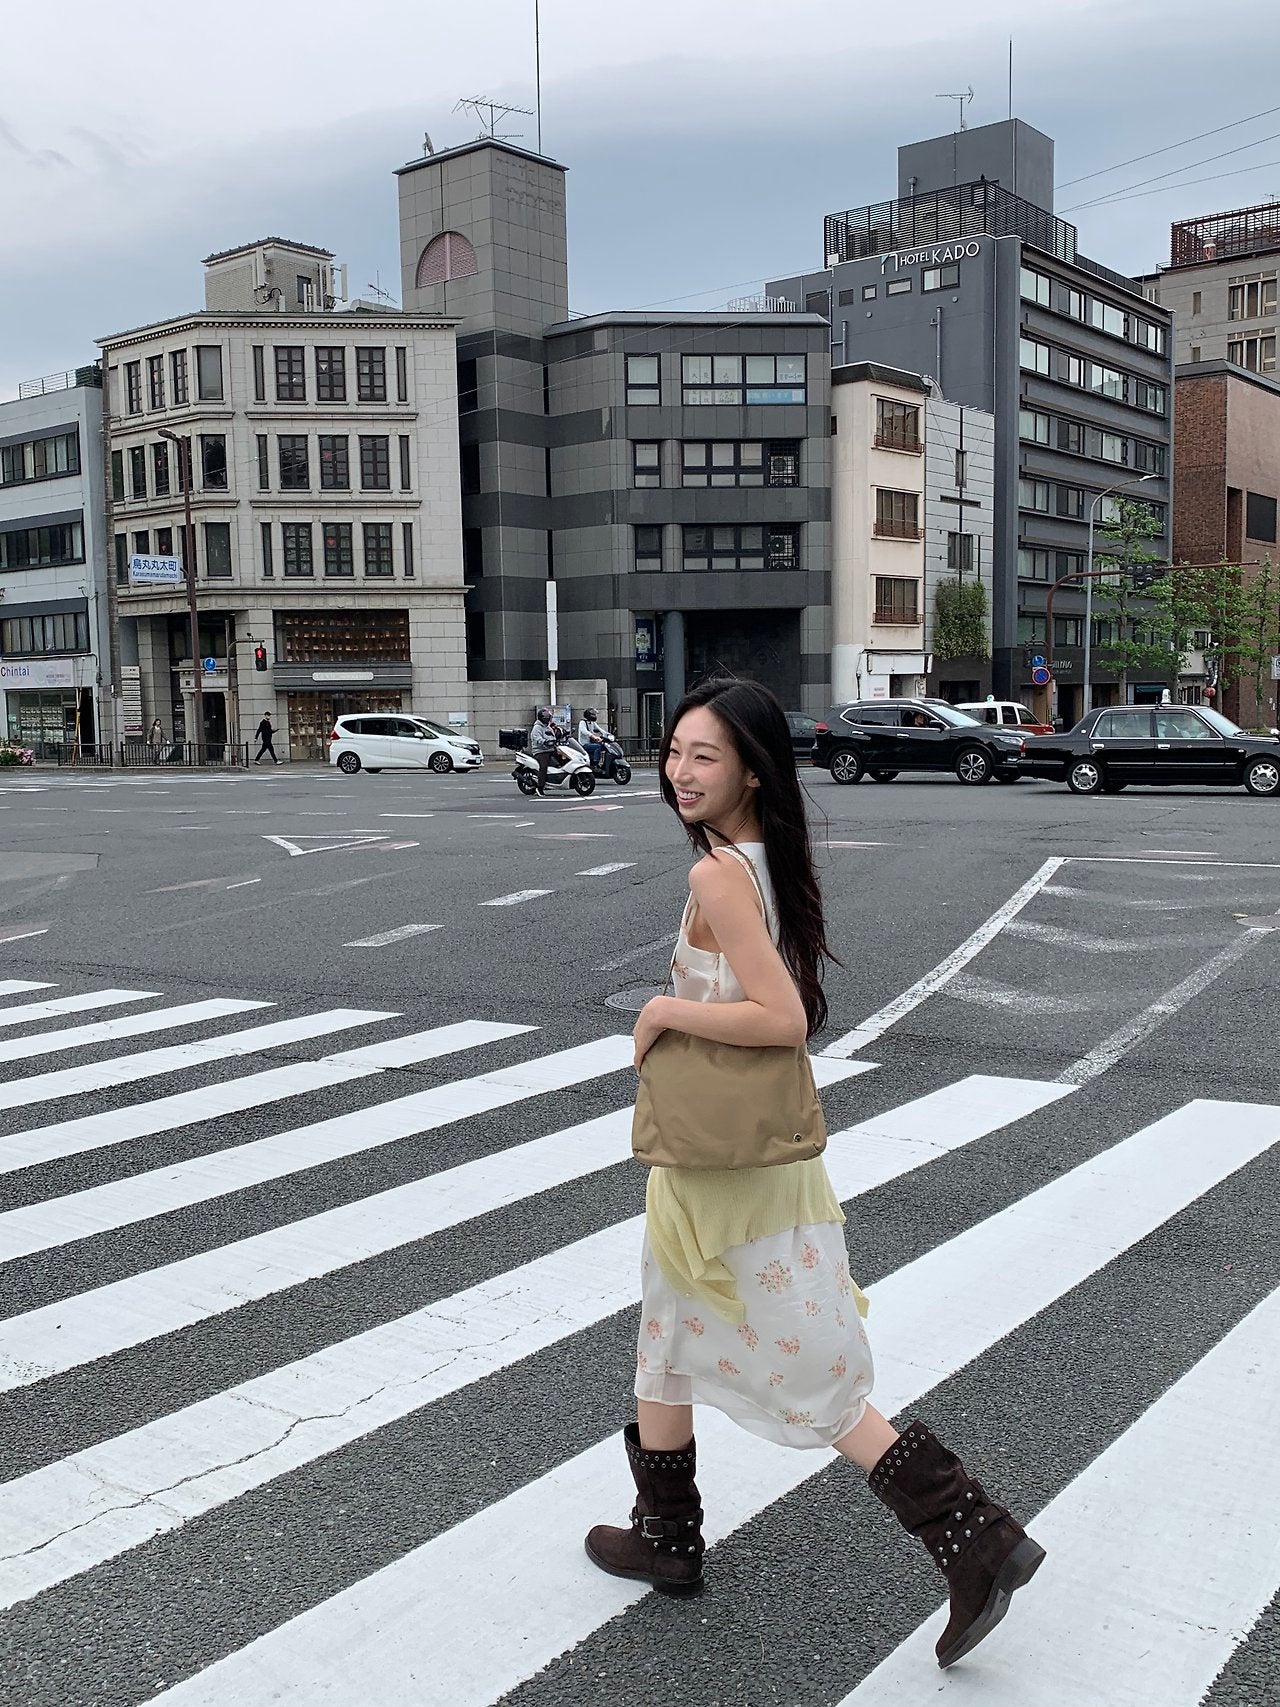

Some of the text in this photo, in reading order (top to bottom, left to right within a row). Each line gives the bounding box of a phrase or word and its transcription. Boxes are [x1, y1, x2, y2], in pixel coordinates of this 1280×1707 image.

[900, 242, 979, 266] HOTEL KADO
[1, 666, 30, 677] Chintai
